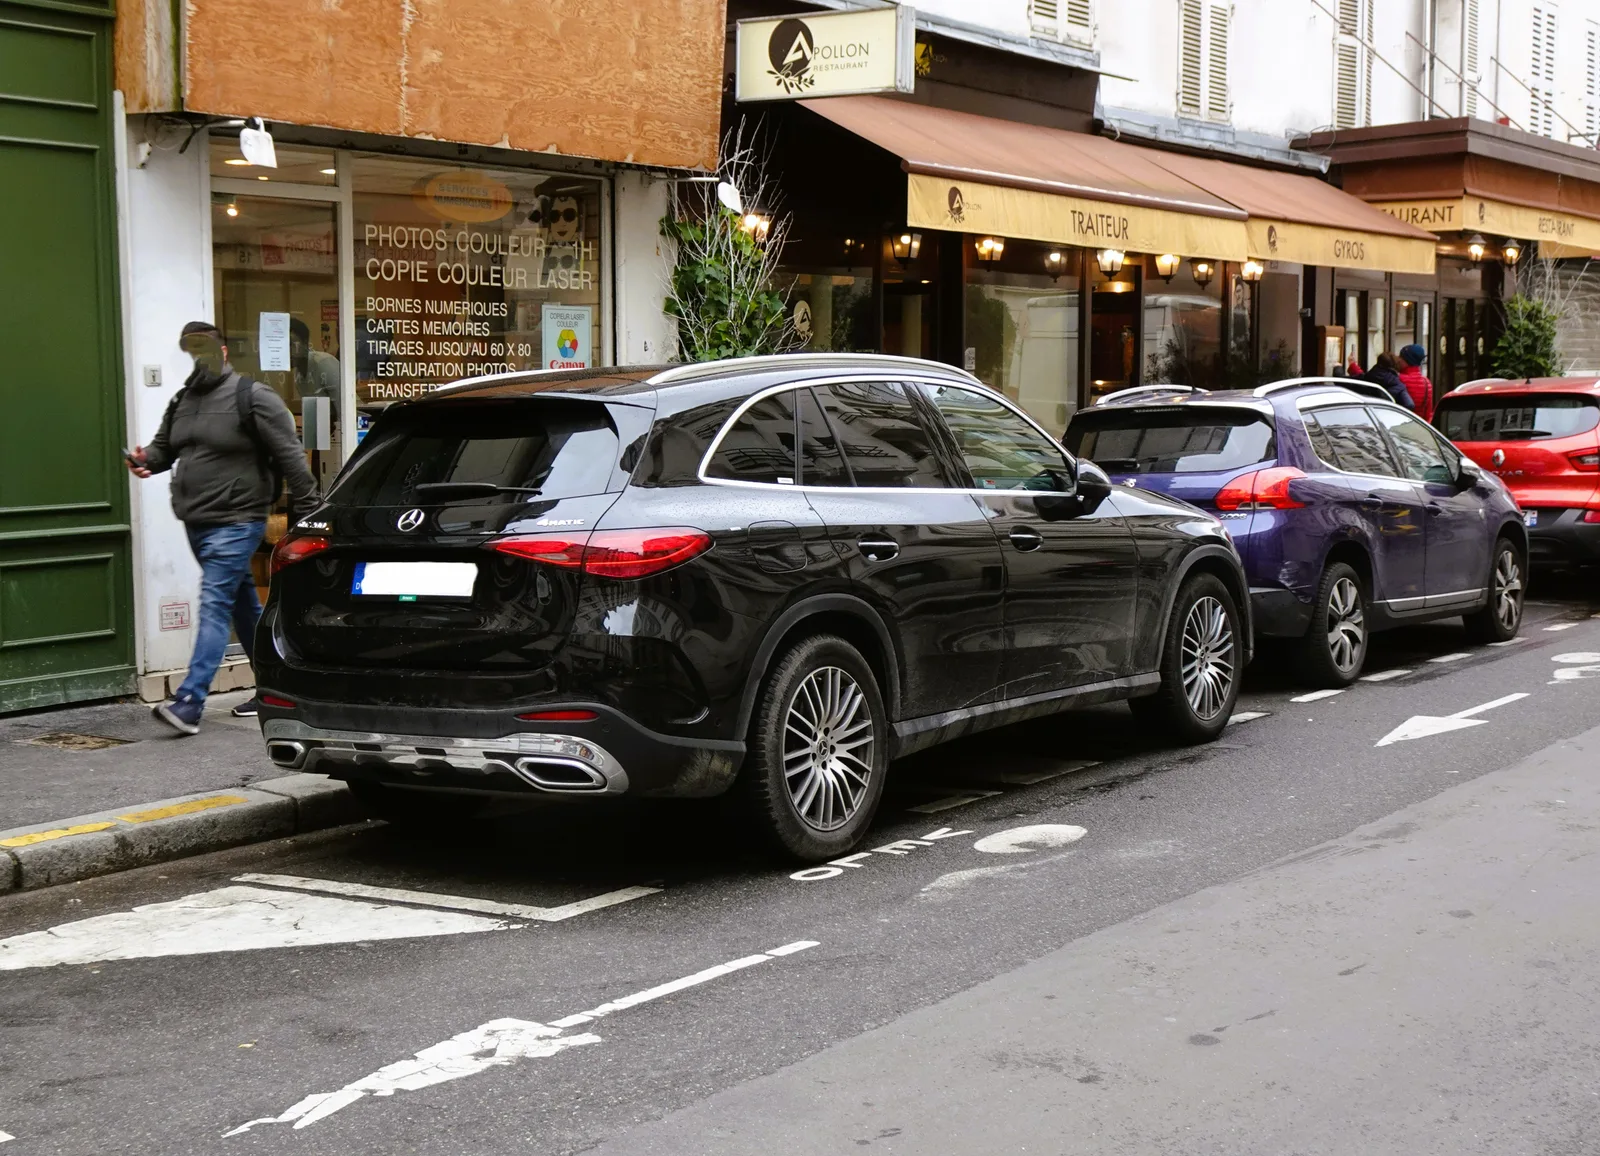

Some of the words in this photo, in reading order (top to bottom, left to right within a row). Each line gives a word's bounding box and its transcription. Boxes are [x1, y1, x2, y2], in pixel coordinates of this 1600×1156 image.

[813, 62, 869, 72] RESTAURANT
[1070, 210, 1129, 240] TRAITEUR
[365, 224, 448, 250] PHOTOS
[456, 230, 546, 258] COULEUR
[572, 240, 593, 260] 1H
[1333, 239, 1365, 260] GYROS
[365, 257, 428, 283] COPIE
[437, 262, 528, 288] COULEUR
[537, 268, 592, 290] LASER
[366, 297, 422, 314] BORNES
[425, 300, 508, 317] NUMERIQUES
[550, 312, 570, 320] COPIEUR
[570, 313, 585, 321] LASER
[556, 320, 579, 328] COULEUR
[366, 318, 420, 335] CARTES
[422, 321, 490, 337] MEMOIRES
[366, 340, 424, 356] TIRAGES
[427, 341, 487, 357] JUSQU'AU
[490, 343, 504, 357] 60
[506, 343, 516, 357] X
[517, 344, 532, 357] 80
[376, 362, 464, 377] ESTAURATION
[466, 363, 516, 377] PHOTOS
[550, 359, 585, 369] Canon
[537, 518, 585, 527] 4MATIC
